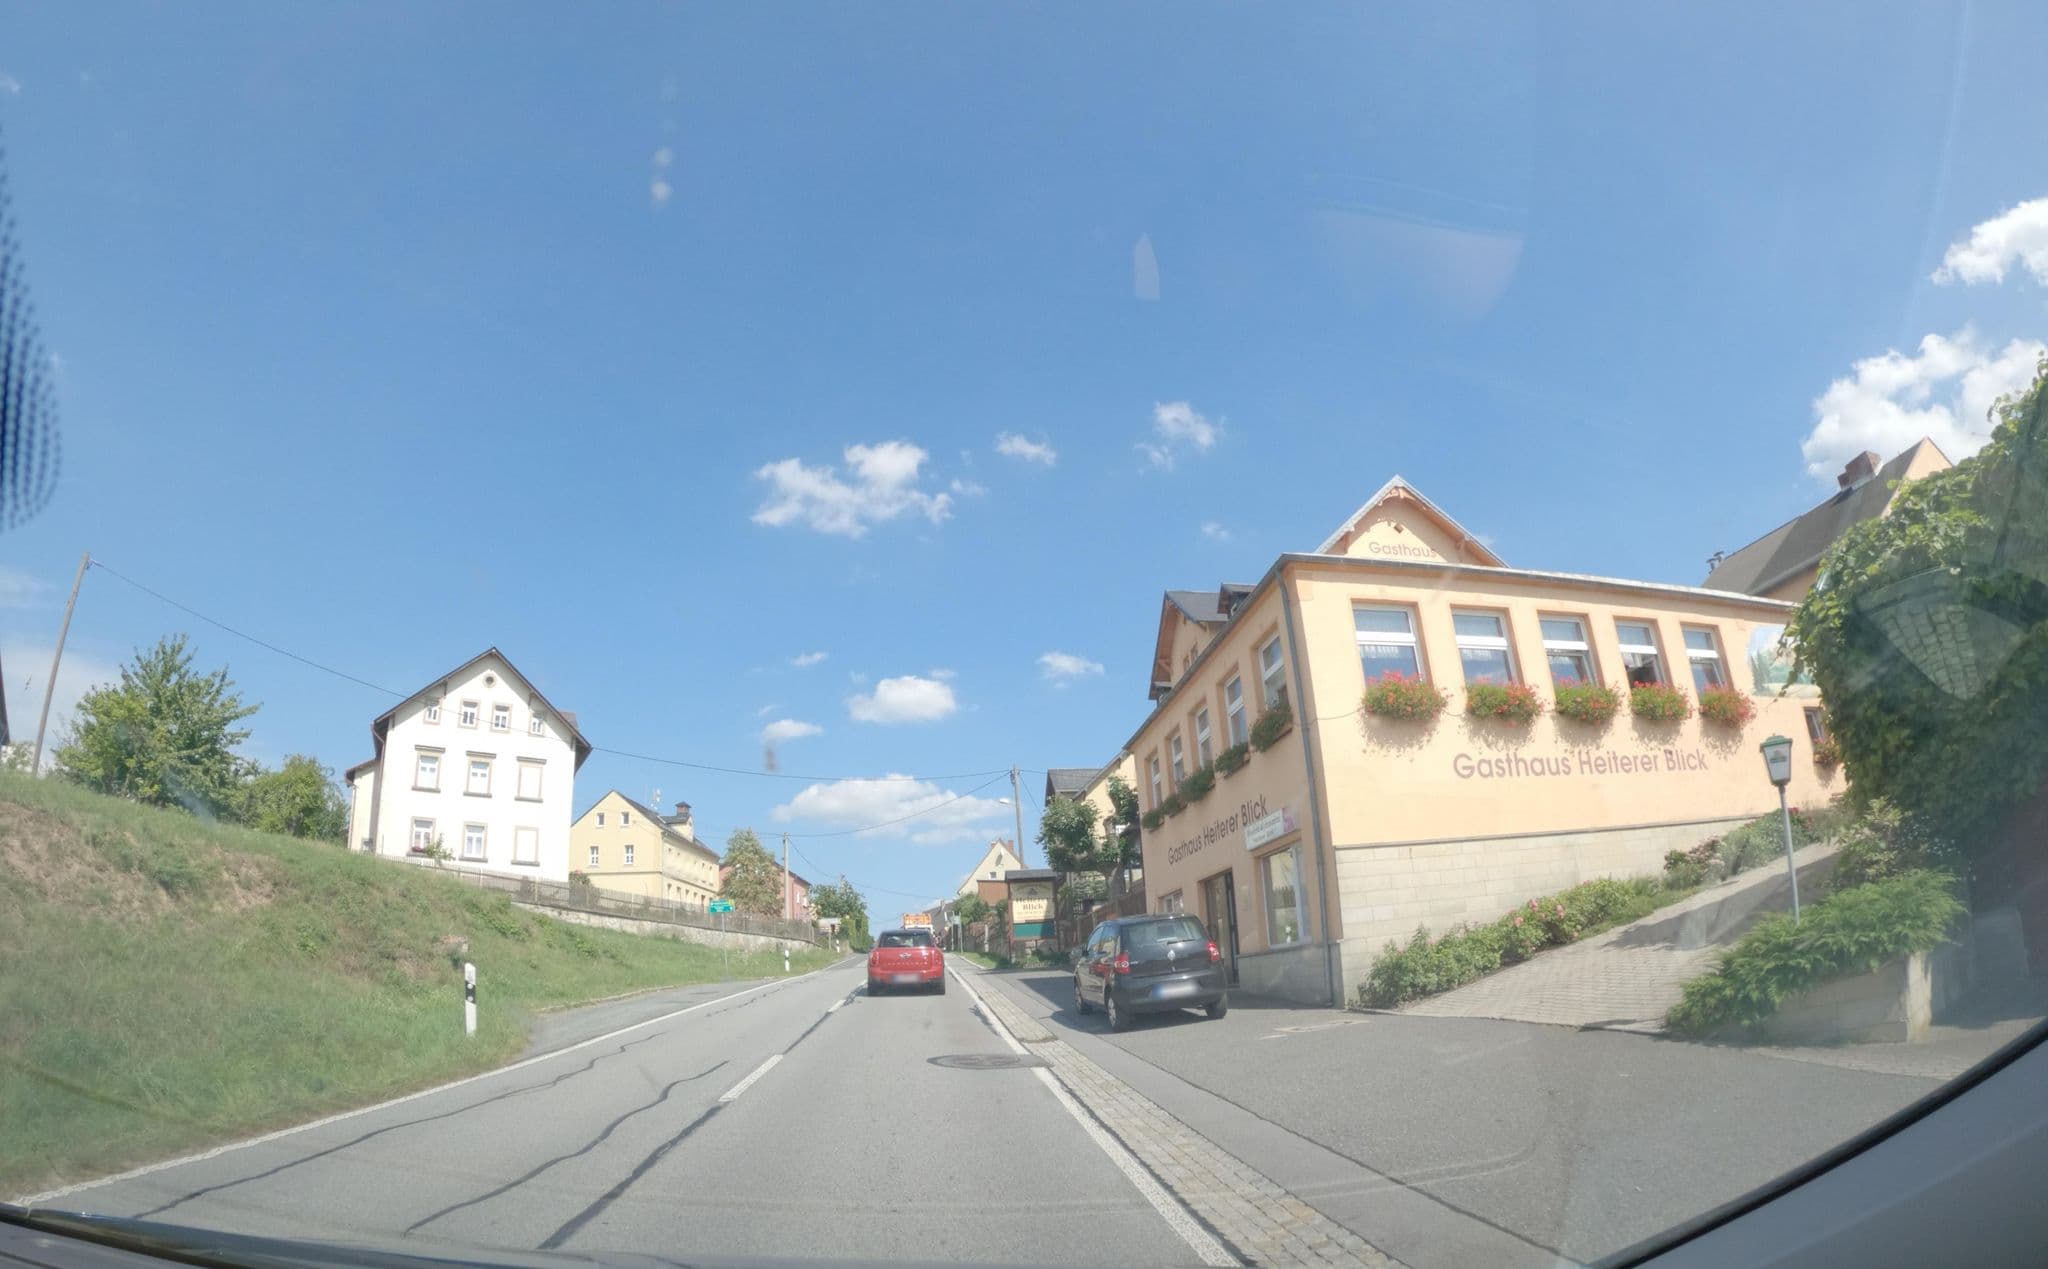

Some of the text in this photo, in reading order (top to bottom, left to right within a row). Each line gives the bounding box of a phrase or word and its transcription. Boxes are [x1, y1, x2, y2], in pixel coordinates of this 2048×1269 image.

[1369, 541, 1437, 558] Gasthaus
[1453, 749, 1708, 779] Gasthaus Heiterer Blick
[1167, 834, 1203, 865] Gasthaus
[1203, 813, 1239, 848] Heiterer
[1241, 793, 1268, 827] Blick
